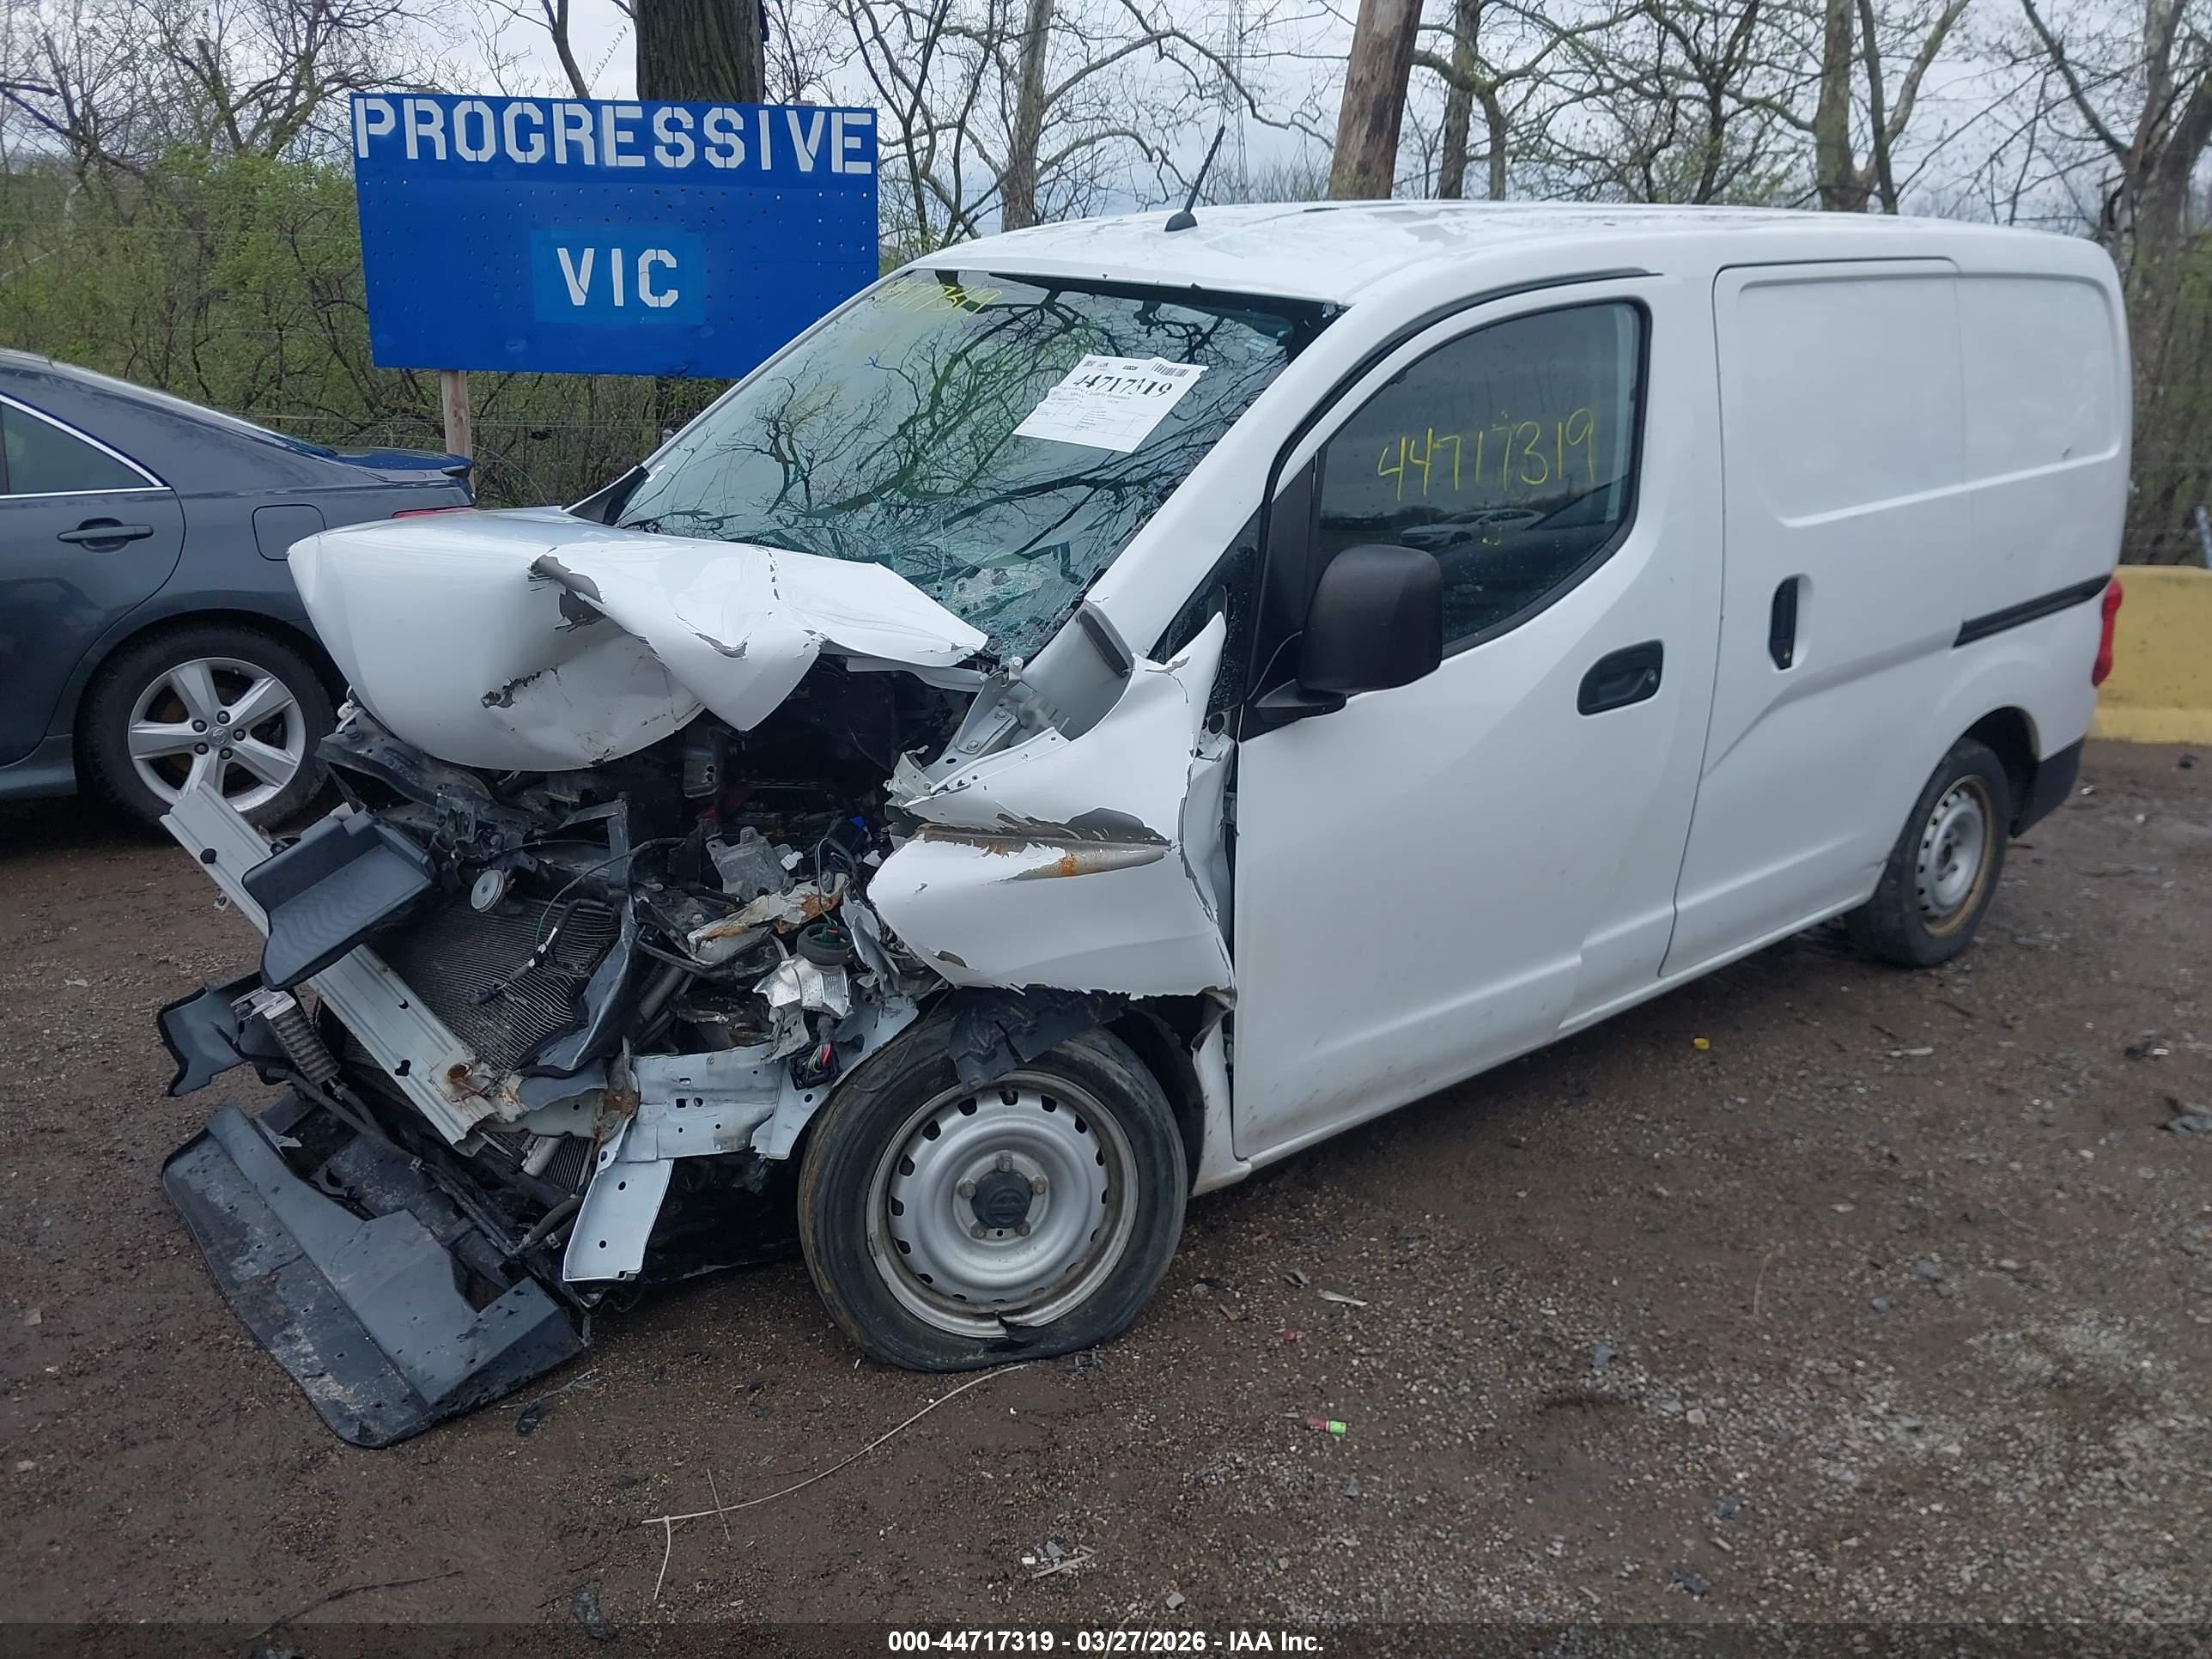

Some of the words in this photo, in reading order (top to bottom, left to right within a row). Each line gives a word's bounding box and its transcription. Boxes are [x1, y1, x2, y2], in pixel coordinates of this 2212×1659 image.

[355, 98, 872, 174] PROGRESSIVE
[557, 247, 678, 307] VIC
[1377, 407, 1595, 501] 44717319
